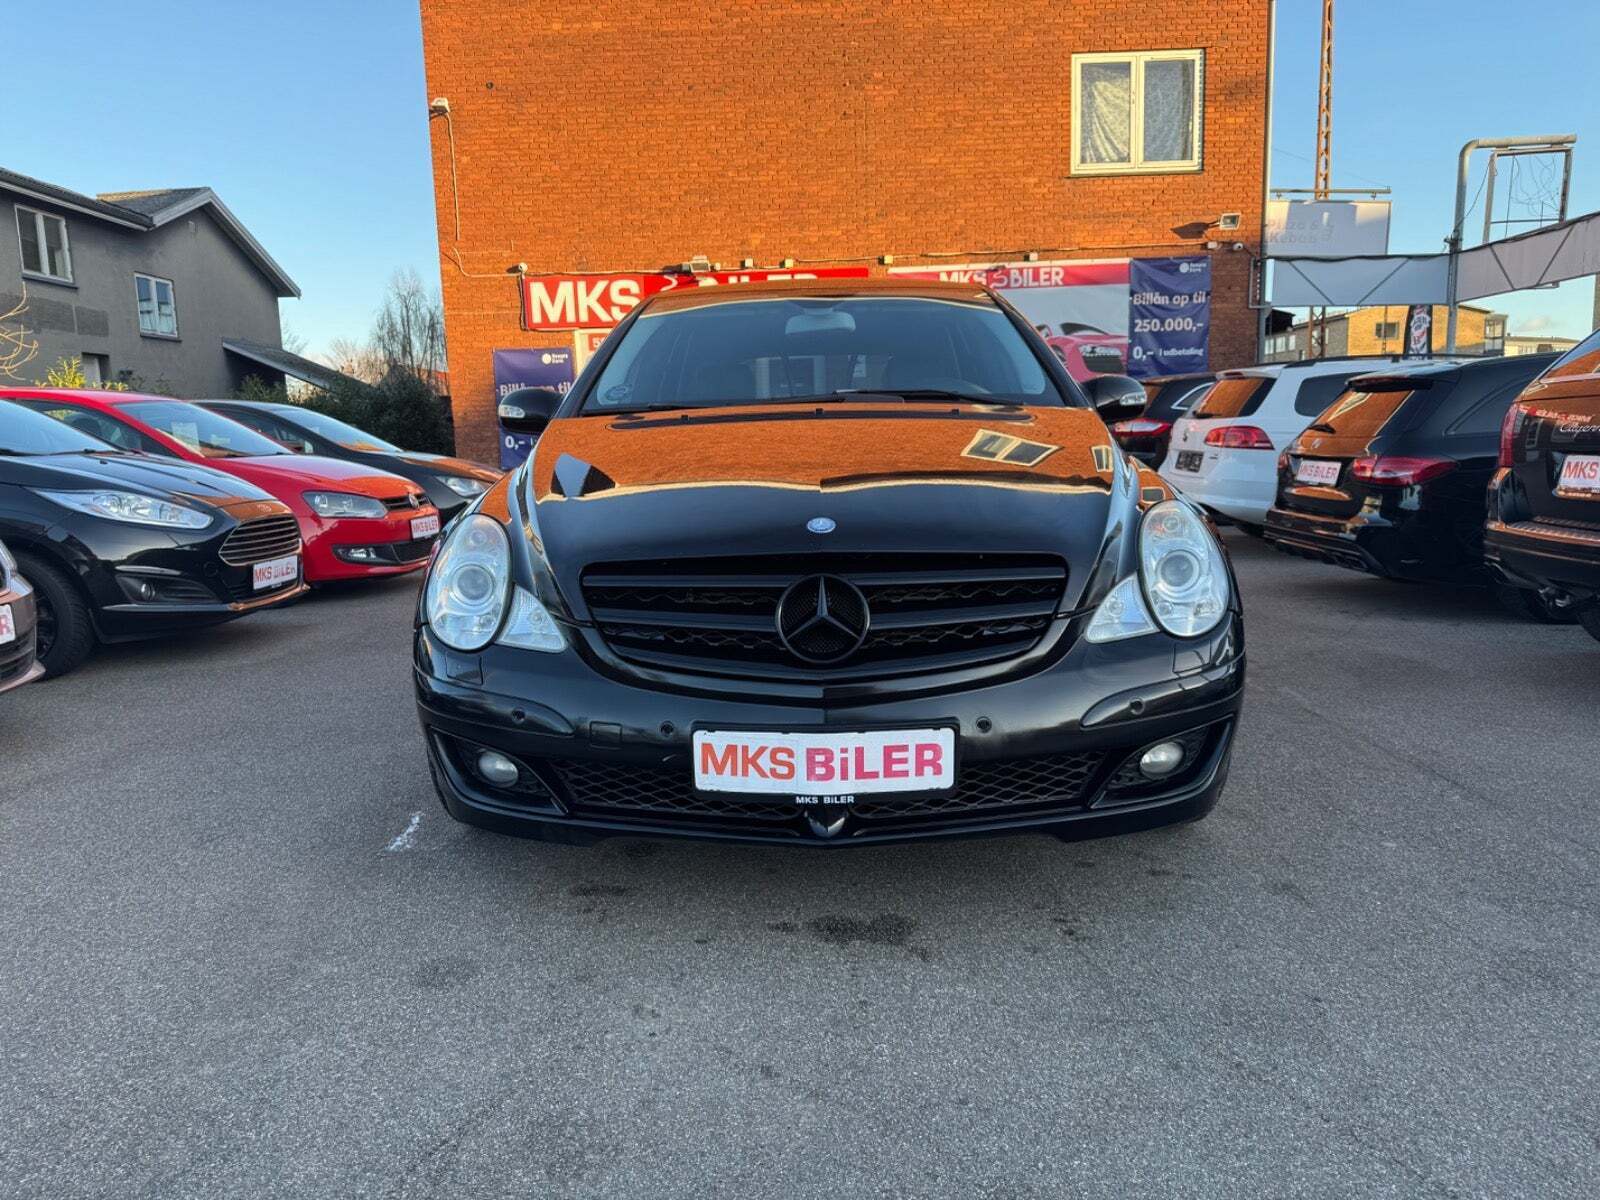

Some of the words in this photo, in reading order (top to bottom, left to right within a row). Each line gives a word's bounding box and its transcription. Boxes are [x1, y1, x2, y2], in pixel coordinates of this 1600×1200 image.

[1009, 267, 1065, 288] BILER
[529, 278, 641, 323] MKS
[1133, 291, 1170, 305] Billån
[1172, 295, 1190, 307] op
[1192, 290, 1206, 304] til
[1134, 317, 1204, 333] 250.000,-
[1563, 461, 1599, 480] MKS
[255, 566, 272, 582] MKS
[701, 742, 796, 781] MKS
[805, 743, 944, 782] BiLER
[795, 796, 819, 804] MKS
[823, 796, 855, 804] BiLER
